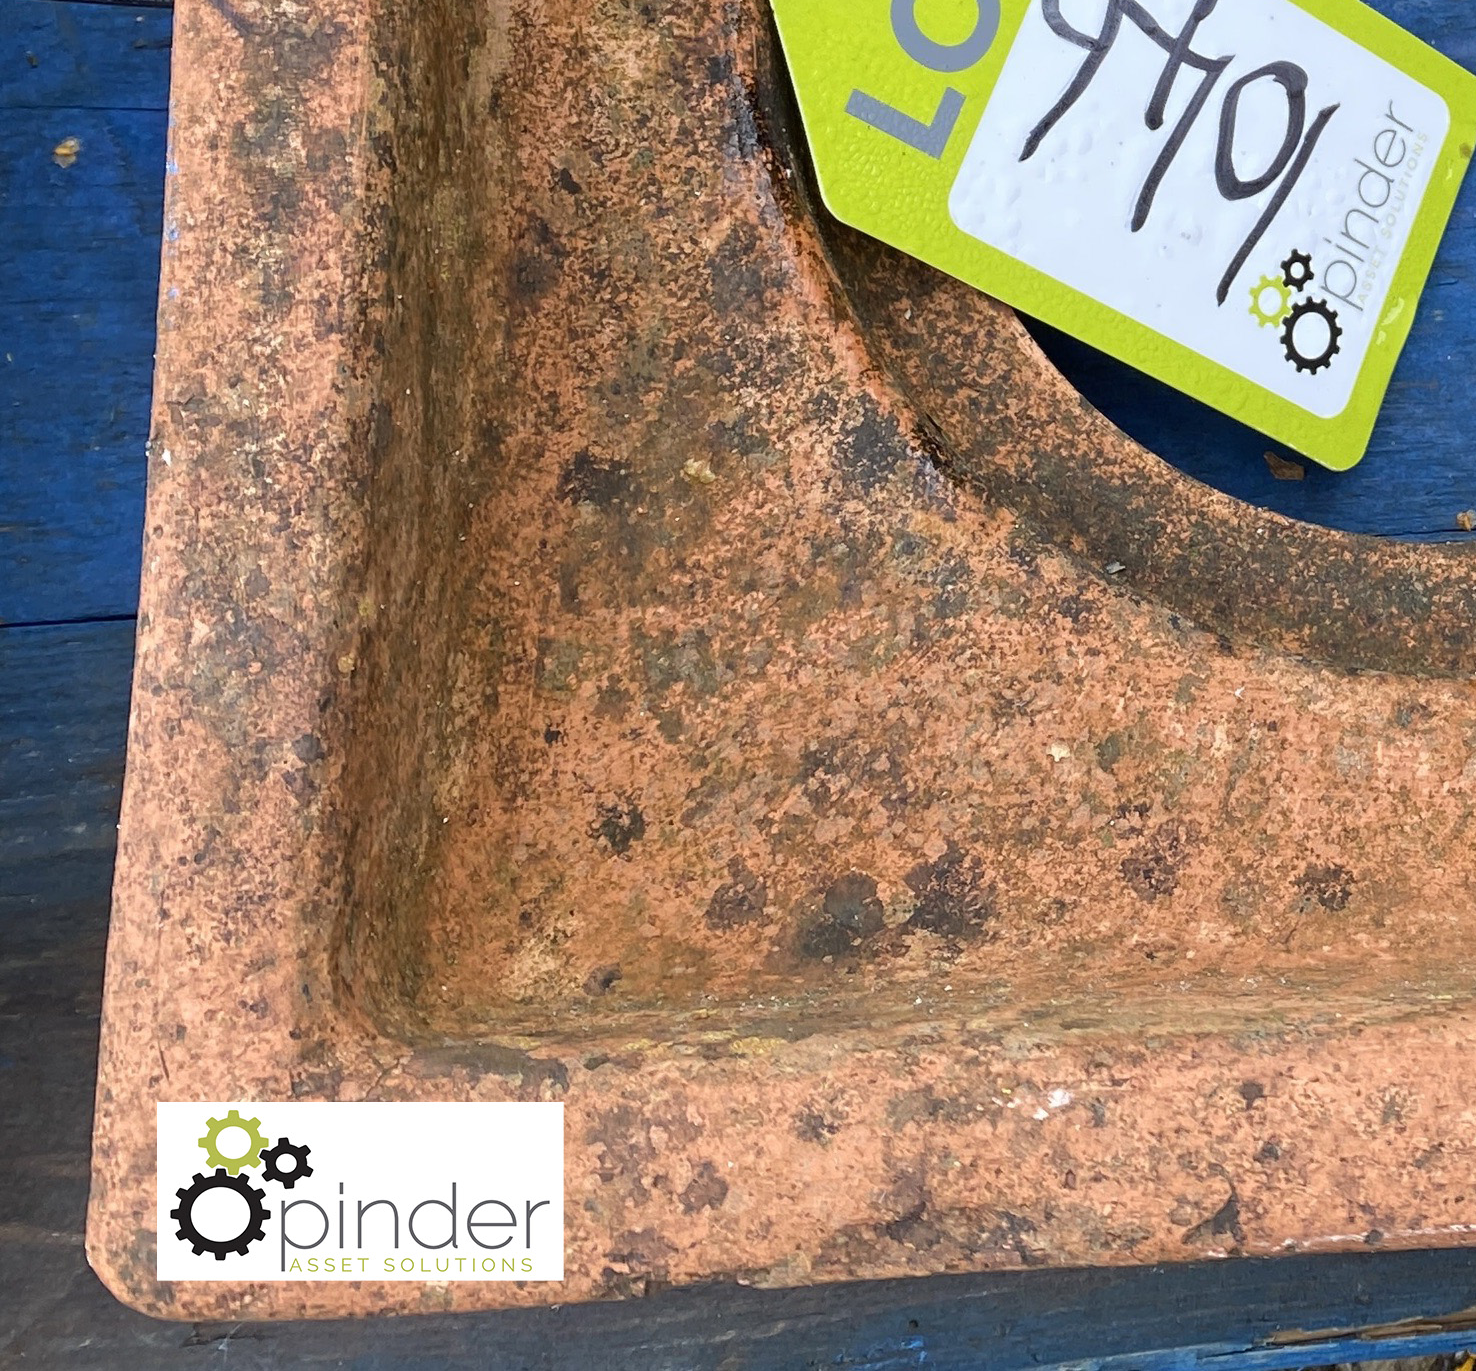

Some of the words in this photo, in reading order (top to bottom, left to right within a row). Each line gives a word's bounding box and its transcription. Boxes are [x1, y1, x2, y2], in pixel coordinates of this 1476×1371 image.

[1320, 99, 1414, 312] pinder
[1357, 244, 1387, 304] ASSET
[1380, 131, 1429, 240] SOLUTIONS
